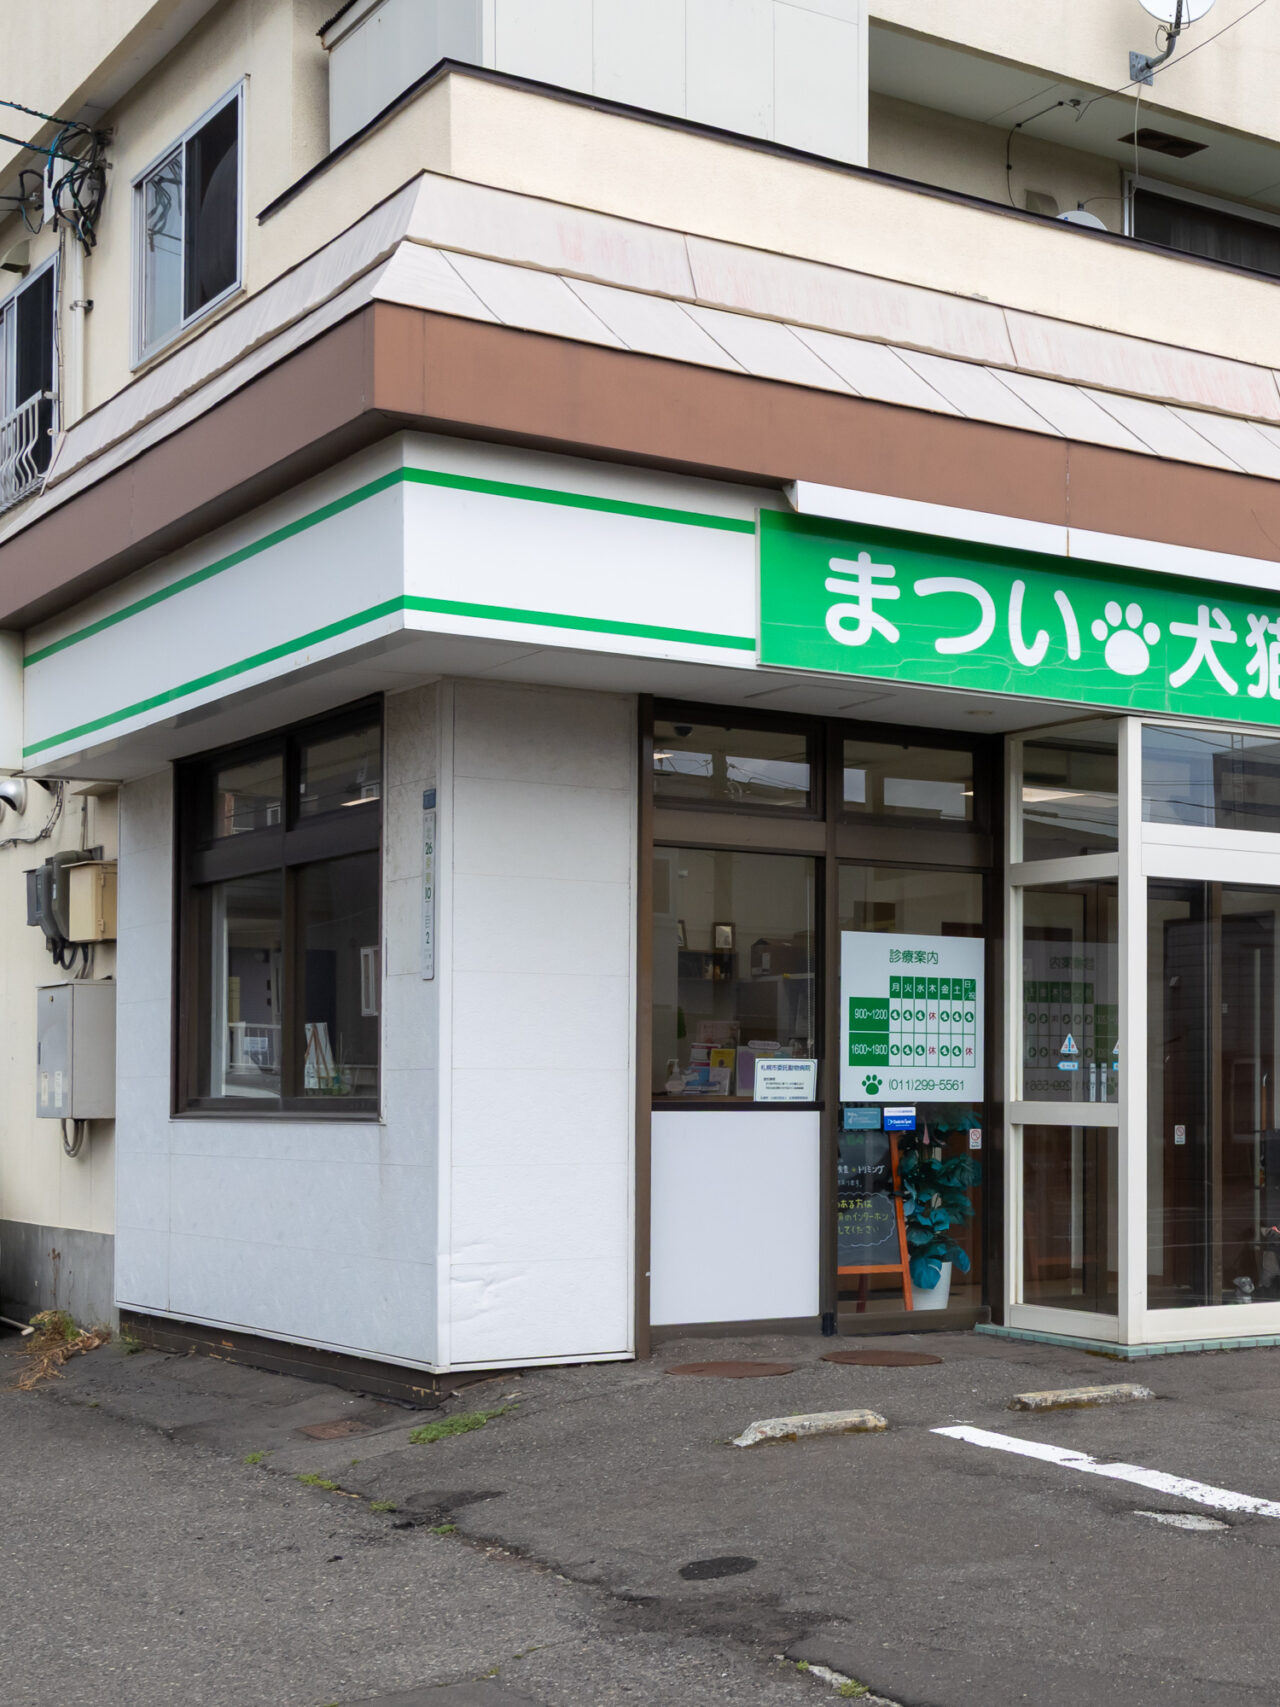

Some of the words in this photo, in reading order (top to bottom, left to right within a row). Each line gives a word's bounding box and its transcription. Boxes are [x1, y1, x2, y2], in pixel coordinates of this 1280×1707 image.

[823, 552, 1081, 666] まつい
[889, 949, 939, 964] 診療案内
[891, 982, 900, 992] 月
[904, 983, 912, 992] 火
[916, 983, 925, 993] 水
[928, 984, 937, 993] 木
[941, 984, 949, 994] 金
[953, 985, 961, 994] 土
[964, 980, 971, 988] 日
[928, 1011, 936, 1020] 休
[928, 1046, 936, 1055] 休
[965, 1047, 973, 1056] 休
[888, 1078, 964, 1091] (011)299-5561
